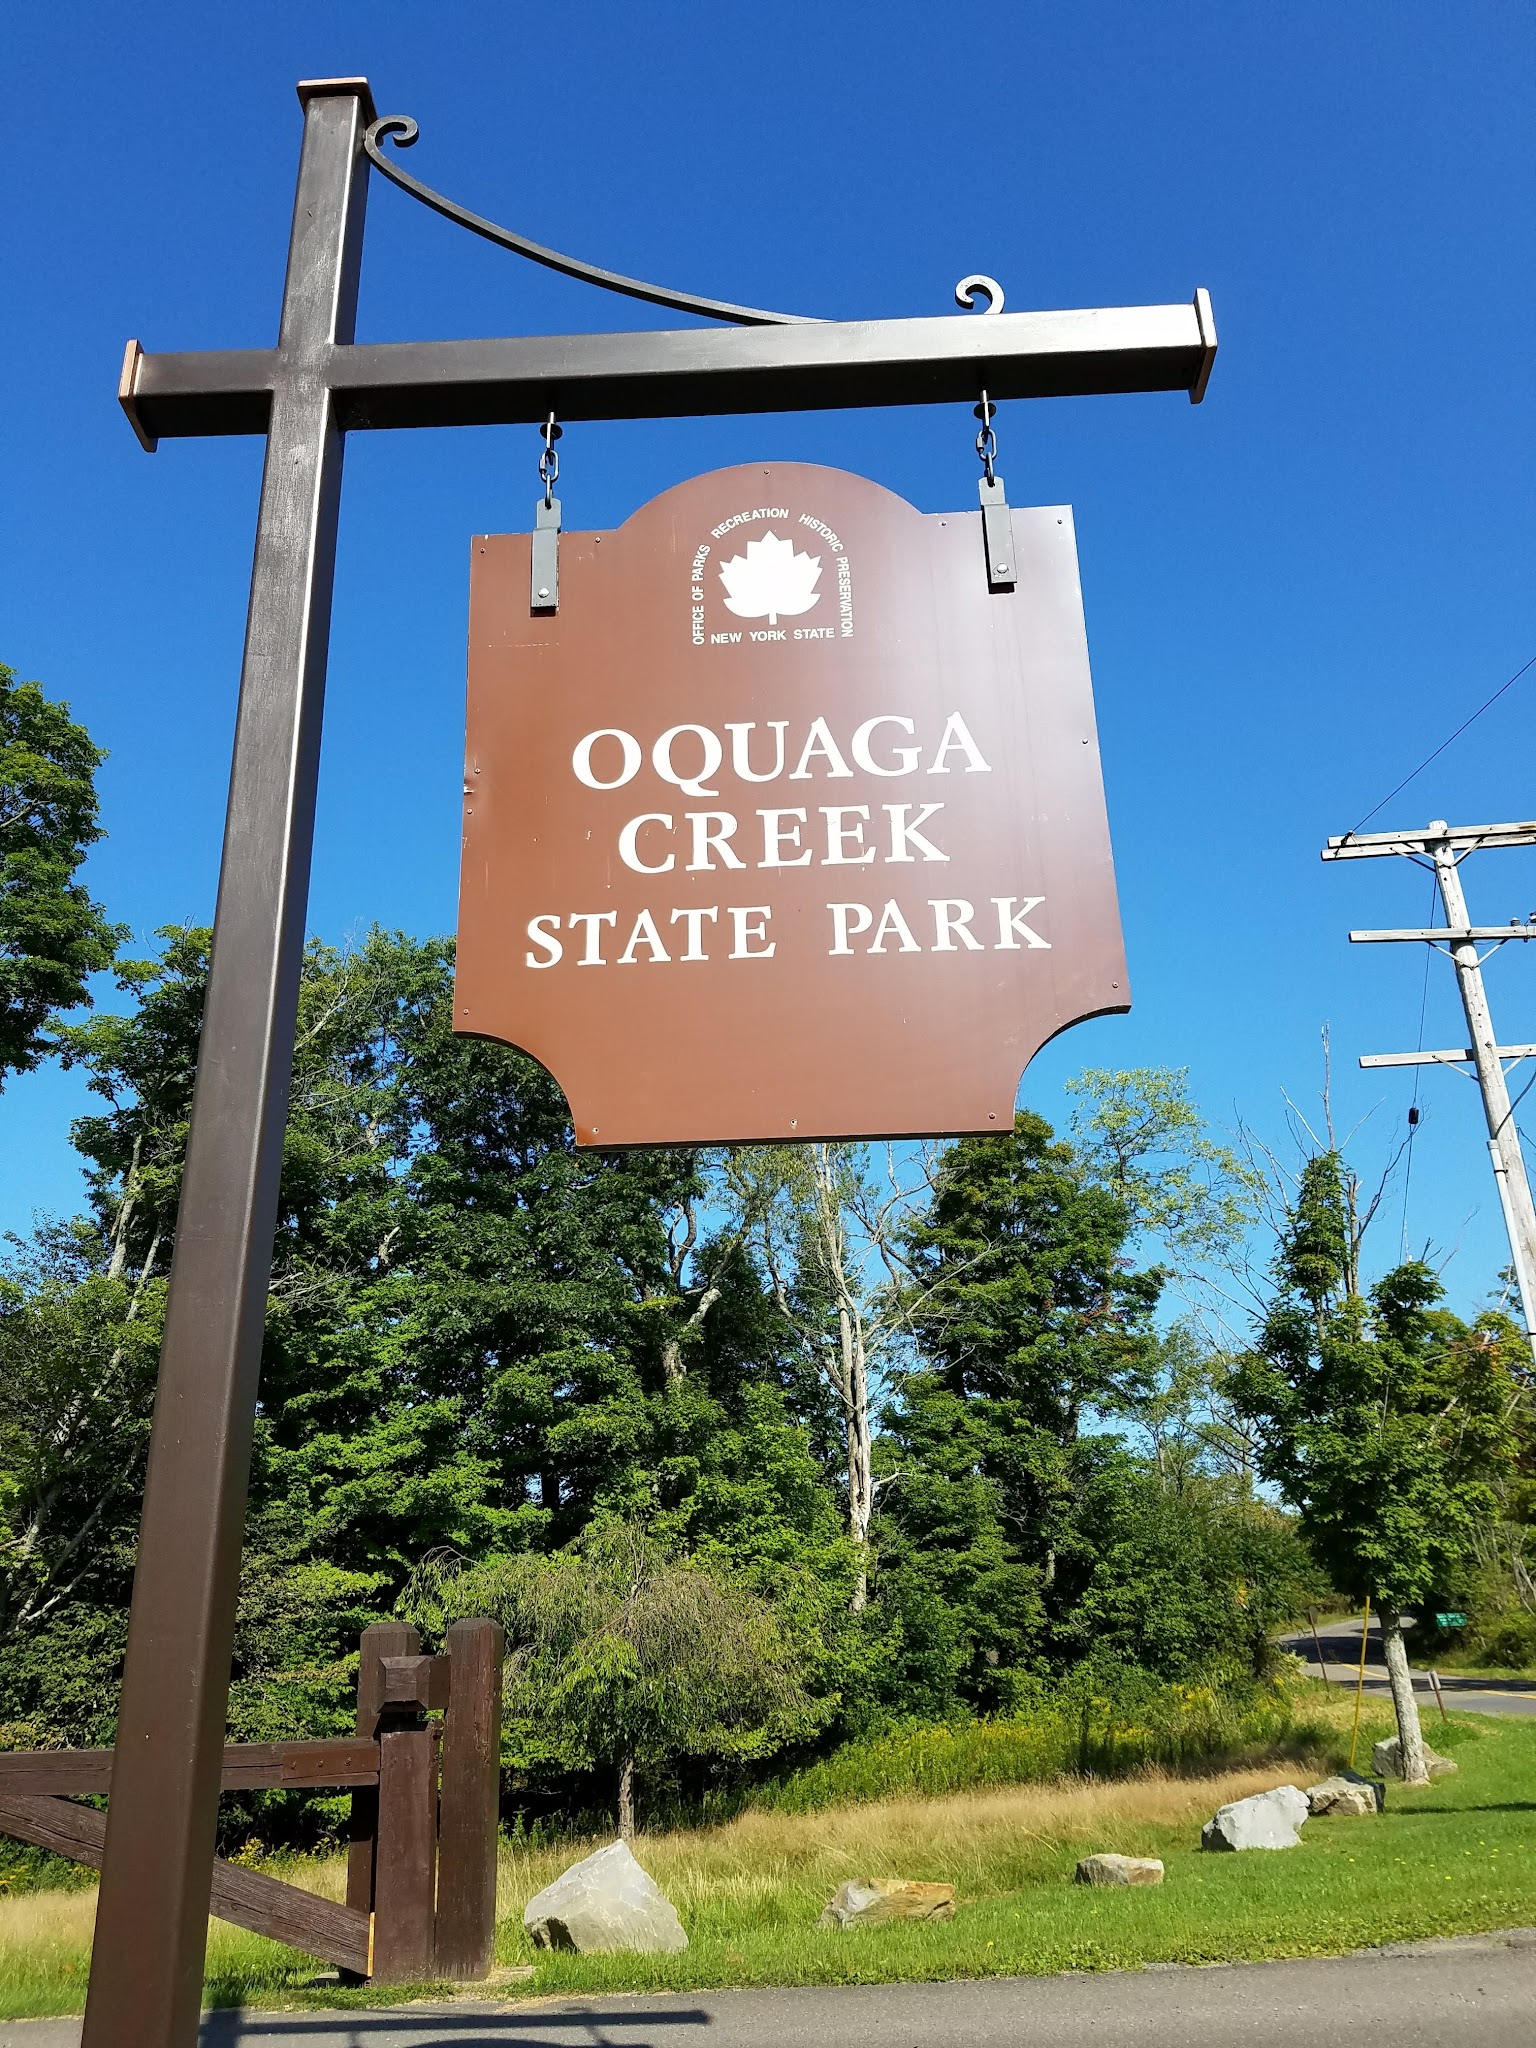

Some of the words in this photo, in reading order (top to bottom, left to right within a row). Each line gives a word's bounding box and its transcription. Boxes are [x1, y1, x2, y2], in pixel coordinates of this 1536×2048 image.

[710, 507, 789, 539] RECREATION
[798, 513, 844, 553] HISTORIC
[691, 544, 711, 581] PARKS
[691, 585, 704, 601] OF
[836, 556, 854, 638] PRESERVATION
[692, 604, 705, 645] OFFICE
[710, 632, 742, 644] NEW
[749, 629, 787, 642] YORK
[793, 627, 835, 640] STATE
[571, 711, 993, 797] OQUAGA
[618, 801, 952, 874] CREEK
[524, 905, 777, 969] STATE
[826, 895, 1053, 956] PARK
